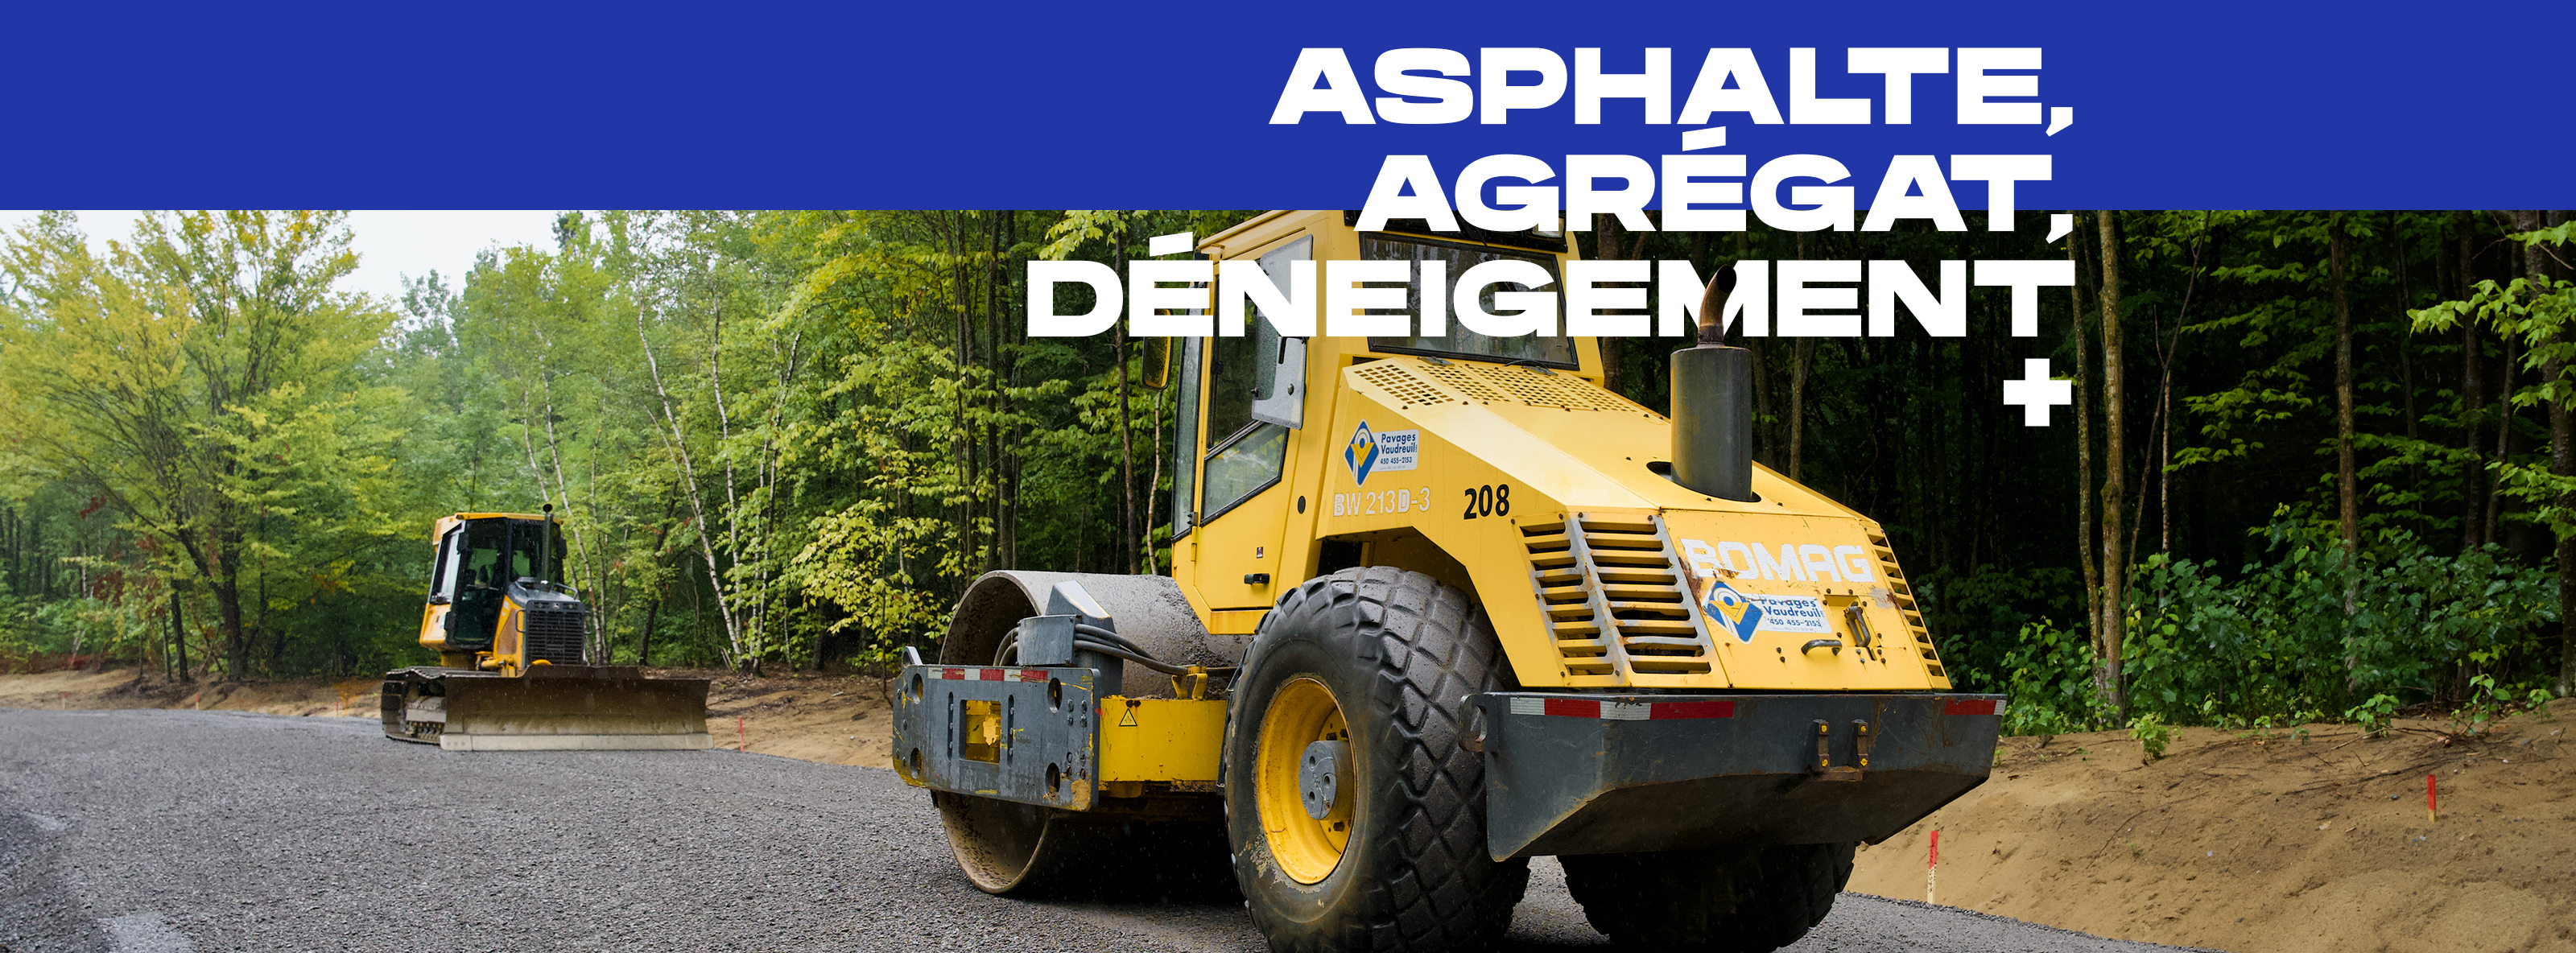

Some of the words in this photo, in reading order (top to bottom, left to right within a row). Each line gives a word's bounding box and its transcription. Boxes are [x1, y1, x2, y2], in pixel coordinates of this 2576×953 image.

[1381, 433, 1416, 445] Pavages
[1381, 442, 1415, 455] Vaudreuil
[1390, 456, 1413, 464] 455-2153
[1333, 493, 1362, 518] BW
[1463, 484, 1510, 520] 208
[1680, 538, 1876, 583] BOMAG
[1763, 605, 1821, 618] Vaudreuil
[1786, 619, 1822, 627] 455-2153
